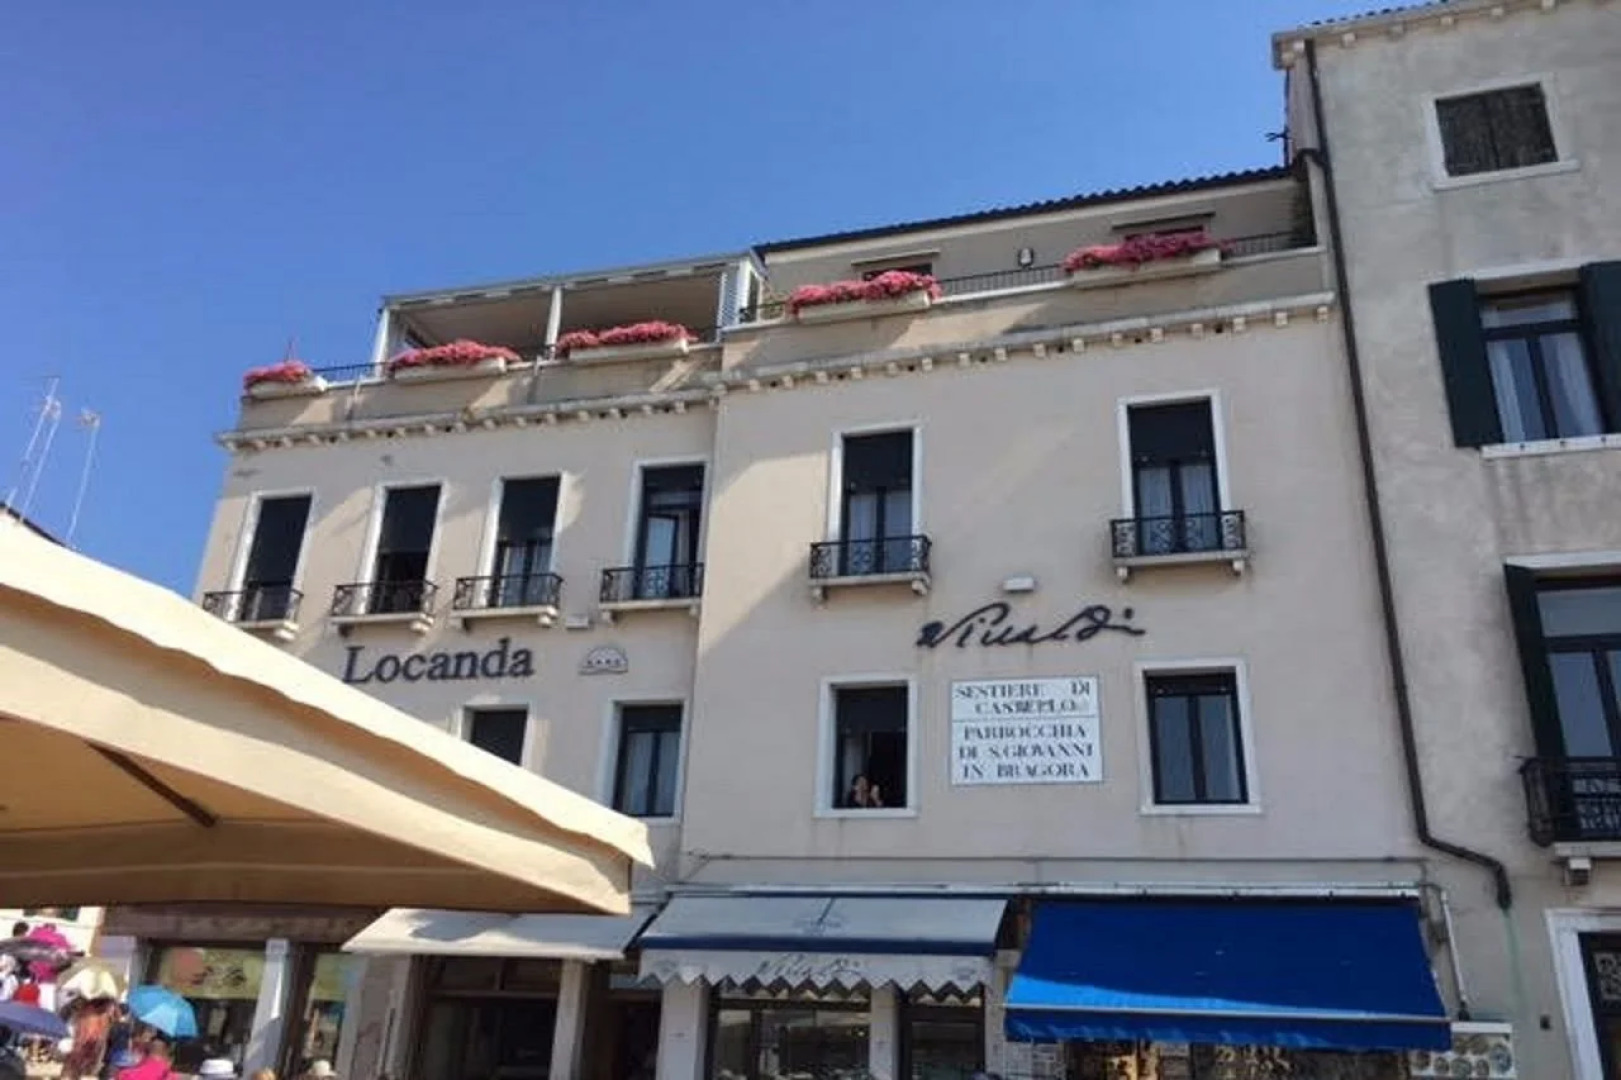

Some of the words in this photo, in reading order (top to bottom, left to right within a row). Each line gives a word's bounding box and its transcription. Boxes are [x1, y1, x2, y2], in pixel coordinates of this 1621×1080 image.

[343, 636, 534, 684] Locanda
[954, 683, 1043, 699] SESTIERE
[1072, 680, 1090, 696] DI
[963, 723, 1087, 740] PARROCCHIA
[963, 763, 984, 779] IN
[997, 762, 1090, 778] BRAGORA
